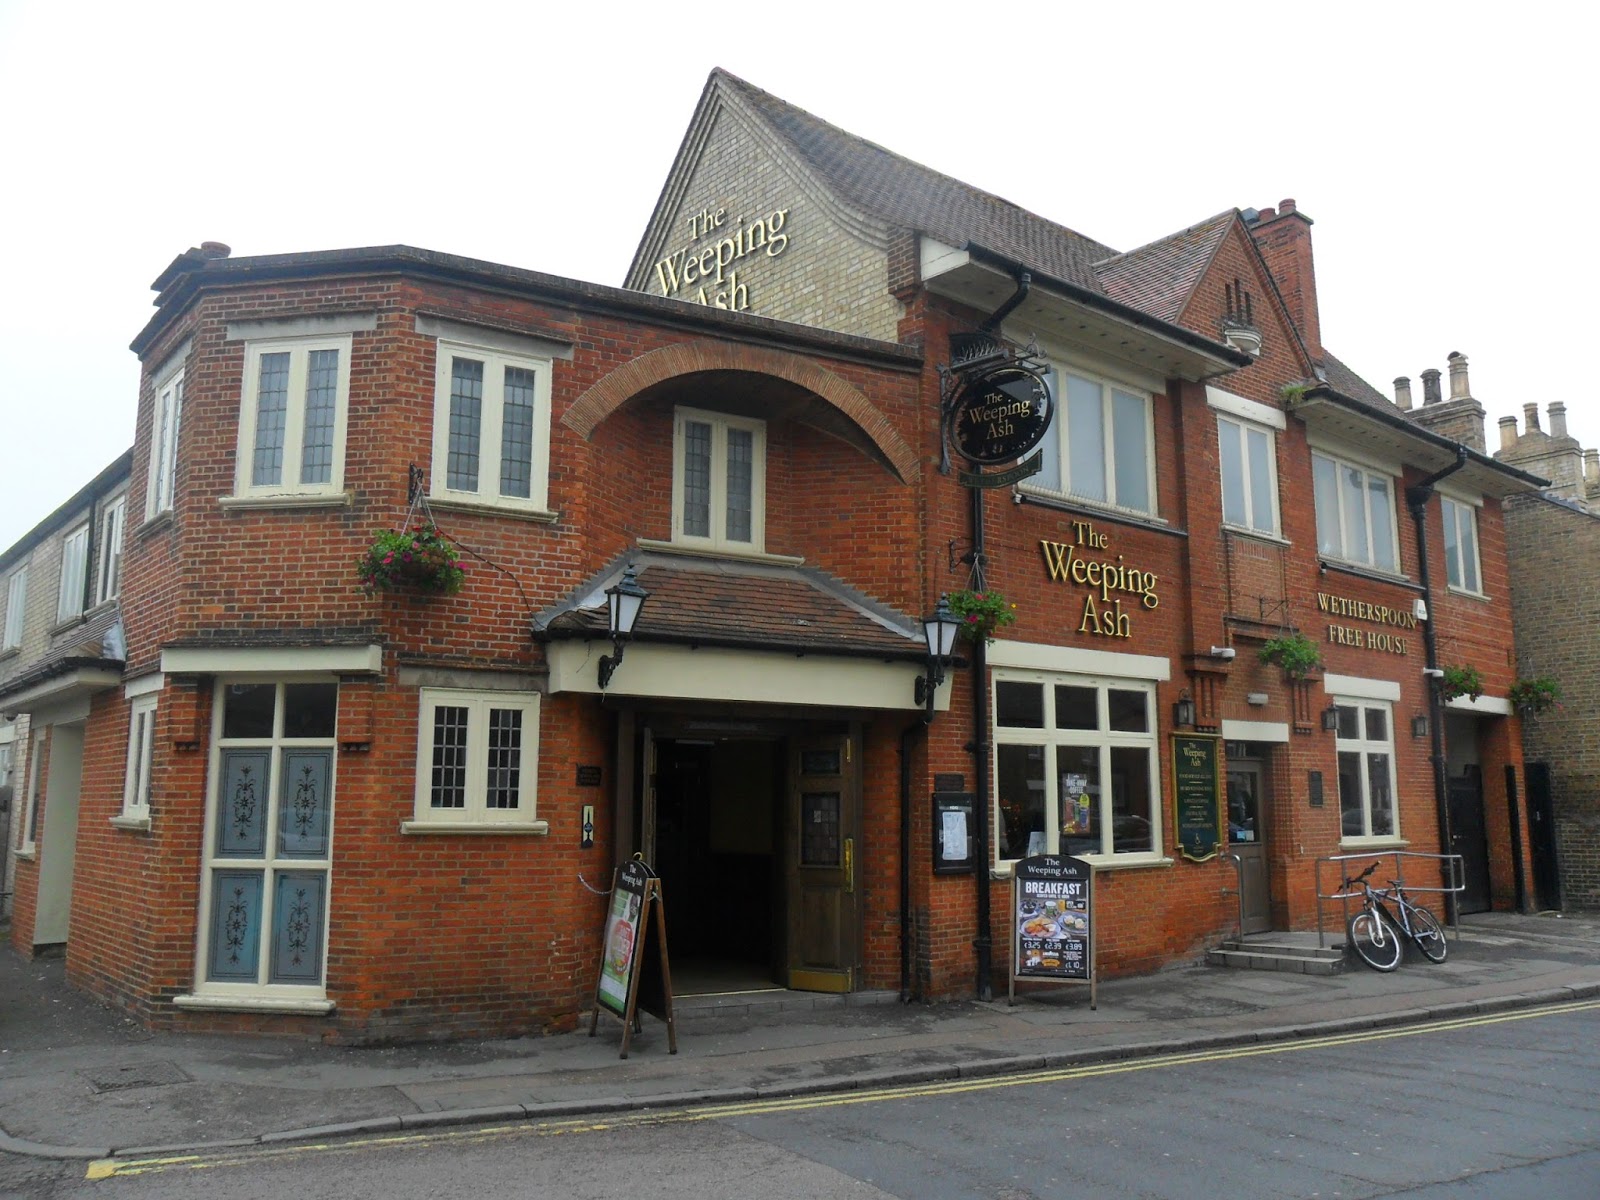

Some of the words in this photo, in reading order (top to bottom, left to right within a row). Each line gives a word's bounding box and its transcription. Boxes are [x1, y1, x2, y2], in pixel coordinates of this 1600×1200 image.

[687, 206, 726, 241] The
[655, 208, 790, 297] Weeping
[984, 392, 1003, 405] The
[969, 399, 1031, 424] Weeping
[986, 418, 1014, 440] Ash
[1072, 520, 1109, 549] The
[1040, 539, 1159, 609] Weeping
[1078, 594, 1132, 638] Ash
[1318, 592, 1417, 629] WETHERSPOON
[1329, 624, 1364, 647] FREE
[1183, 747, 1206, 760] Weeping
[1190, 757, 1201, 767] Ash
[1027, 866, 1061, 876] Weeping
[1062, 867, 1077, 875] Ash
[1045, 857, 1060, 866] The
[1025, 881, 1082, 895] BREAKFAST
